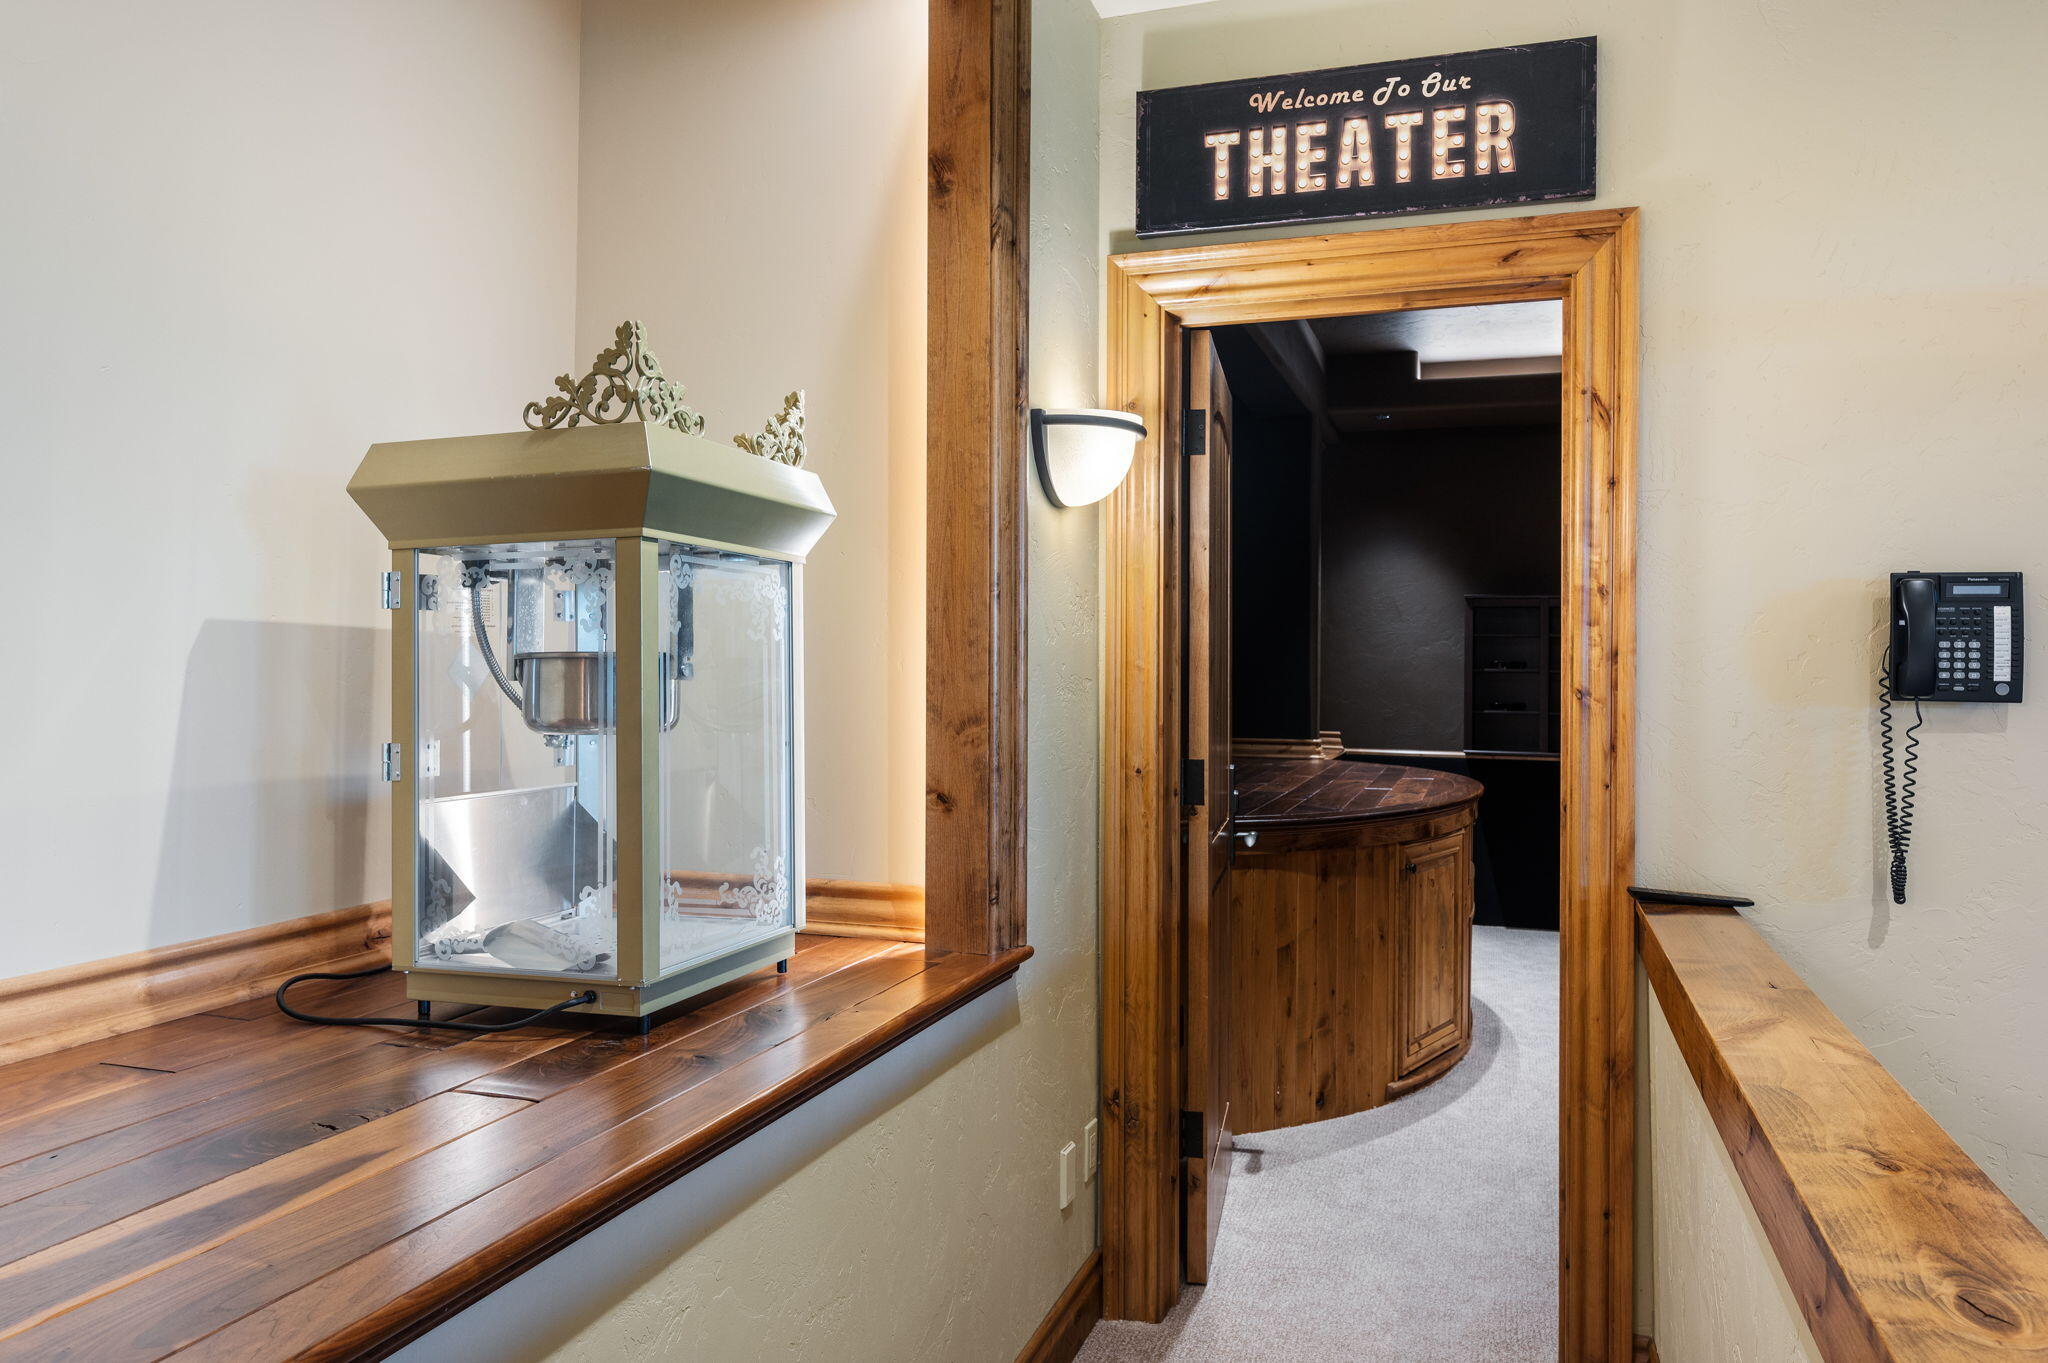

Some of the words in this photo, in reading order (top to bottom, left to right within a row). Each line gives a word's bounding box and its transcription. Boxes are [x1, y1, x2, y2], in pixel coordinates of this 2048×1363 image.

[1249, 89, 1364, 113] Welcome
[1373, 77, 1411, 105] To
[1421, 71, 1471, 97] Our
[1205, 99, 1516, 200] THEATER
